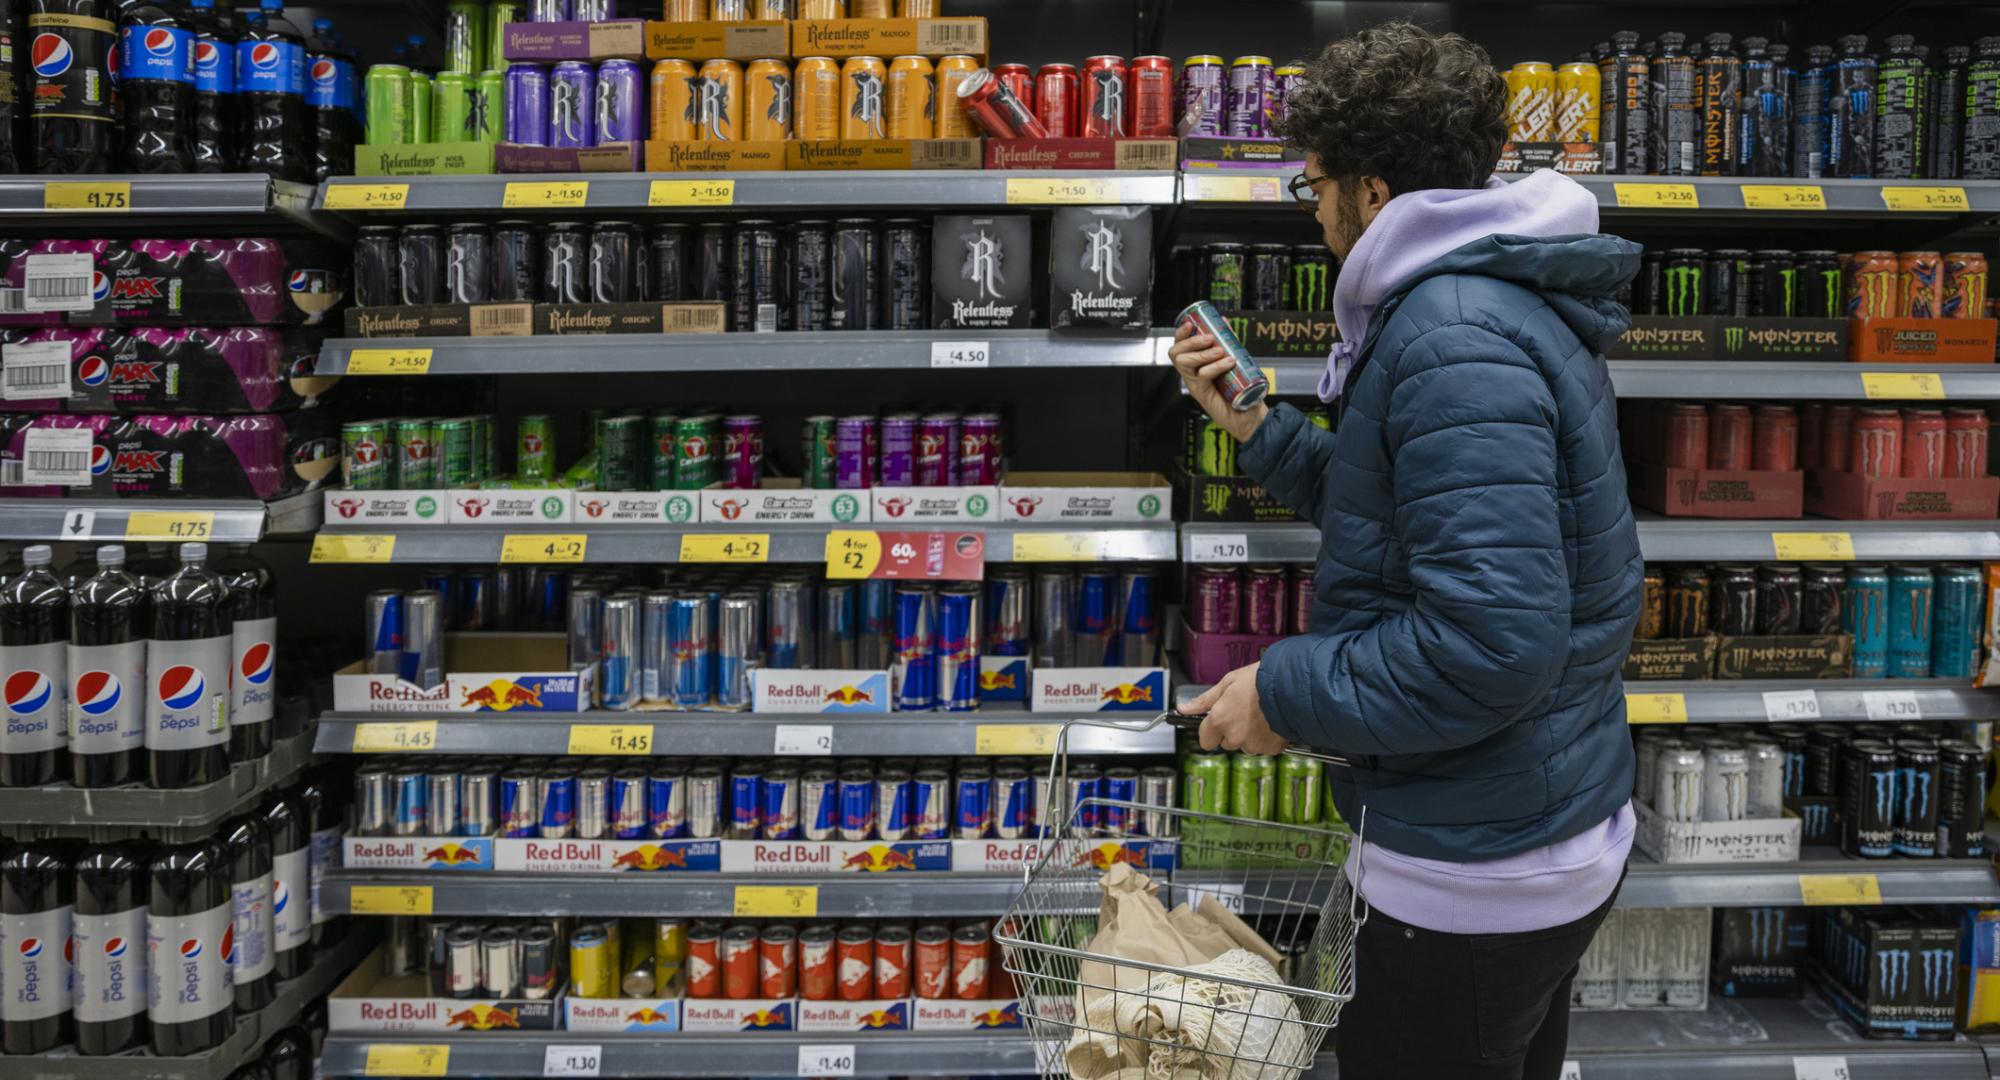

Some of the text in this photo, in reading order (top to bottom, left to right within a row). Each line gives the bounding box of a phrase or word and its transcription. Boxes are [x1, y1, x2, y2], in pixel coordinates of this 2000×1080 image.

[147, 58, 173, 66] pepsi
[1554, 160, 1601, 172] ALERT
[366, 192, 372, 200] 2
[546, 190, 552, 198] 2
[691, 188, 697, 196] 2
[1048, 187, 1054, 196] 2
[1656, 192, 1662, 200] 2
[88, 192, 125, 208] £1.75
[1926, 195, 1932, 203] 2
[111, 276, 167, 299] MAX
[1071, 288, 1133, 318] Relentless
[952, 298, 1014, 326] Relentless
[359, 312, 420, 337] Relentless
[549, 309, 612, 334] Relentless
[1256, 319, 1336, 342] MONST
[1748, 327, 1839, 344] MONSTER
[1894, 331, 1936, 341] JUICED
[390, 357, 396, 366] 2
[950, 352, 984, 362] £4.50
[108, 361, 164, 384] MAX
[112, 450, 168, 473] MAX
[669, 502, 687, 514] 63
[763, 496, 853, 514] Carabao 63
[170, 521, 206, 536] £1.75
[544, 542, 554, 556] 4
[567, 542, 580, 556] £2
[724, 542, 733, 554] 4
[746, 542, 760, 556] £2
[843, 538, 868, 550] 4 for
[890, 543, 917, 558] 60p
[1214, 545, 1245, 557] £1.70
[844, 552, 864, 569] £2
[1752, 647, 1827, 660] MONSTER
[768, 685, 820, 697] Red Bull
[1044, 684, 1098, 697] Red Bull
[7, 719, 48, 736] pepsi
[78, 720, 118, 736] pepsi
[160, 716, 200, 732] pepsi
[394, 731, 431, 746] £1.45
[610, 736, 648, 750] £1.45
[817, 736, 830, 750] £2
[1705, 834, 1786, 848] MONSTER
[354, 844, 414, 856] Red Bull
[526, 844, 601, 860] Red Bull
[754, 845, 830, 862] Red Bull
[986, 844, 1023, 860] Red
[24, 961, 39, 1003] pepsi
[110, 960, 124, 1002] pepsi
[186, 962, 200, 1003] pepsi
[361, 1003, 436, 1020] Red Bull
[573, 1006, 620, 1018] Red Bull
[688, 1008, 734, 1019] Red Bull
[804, 1008, 850, 1020] Red Bull
[919, 1008, 966, 1018] Red Bull
[567, 1056, 596, 1070] £1.30
[819, 1058, 850, 1070] £1.40
